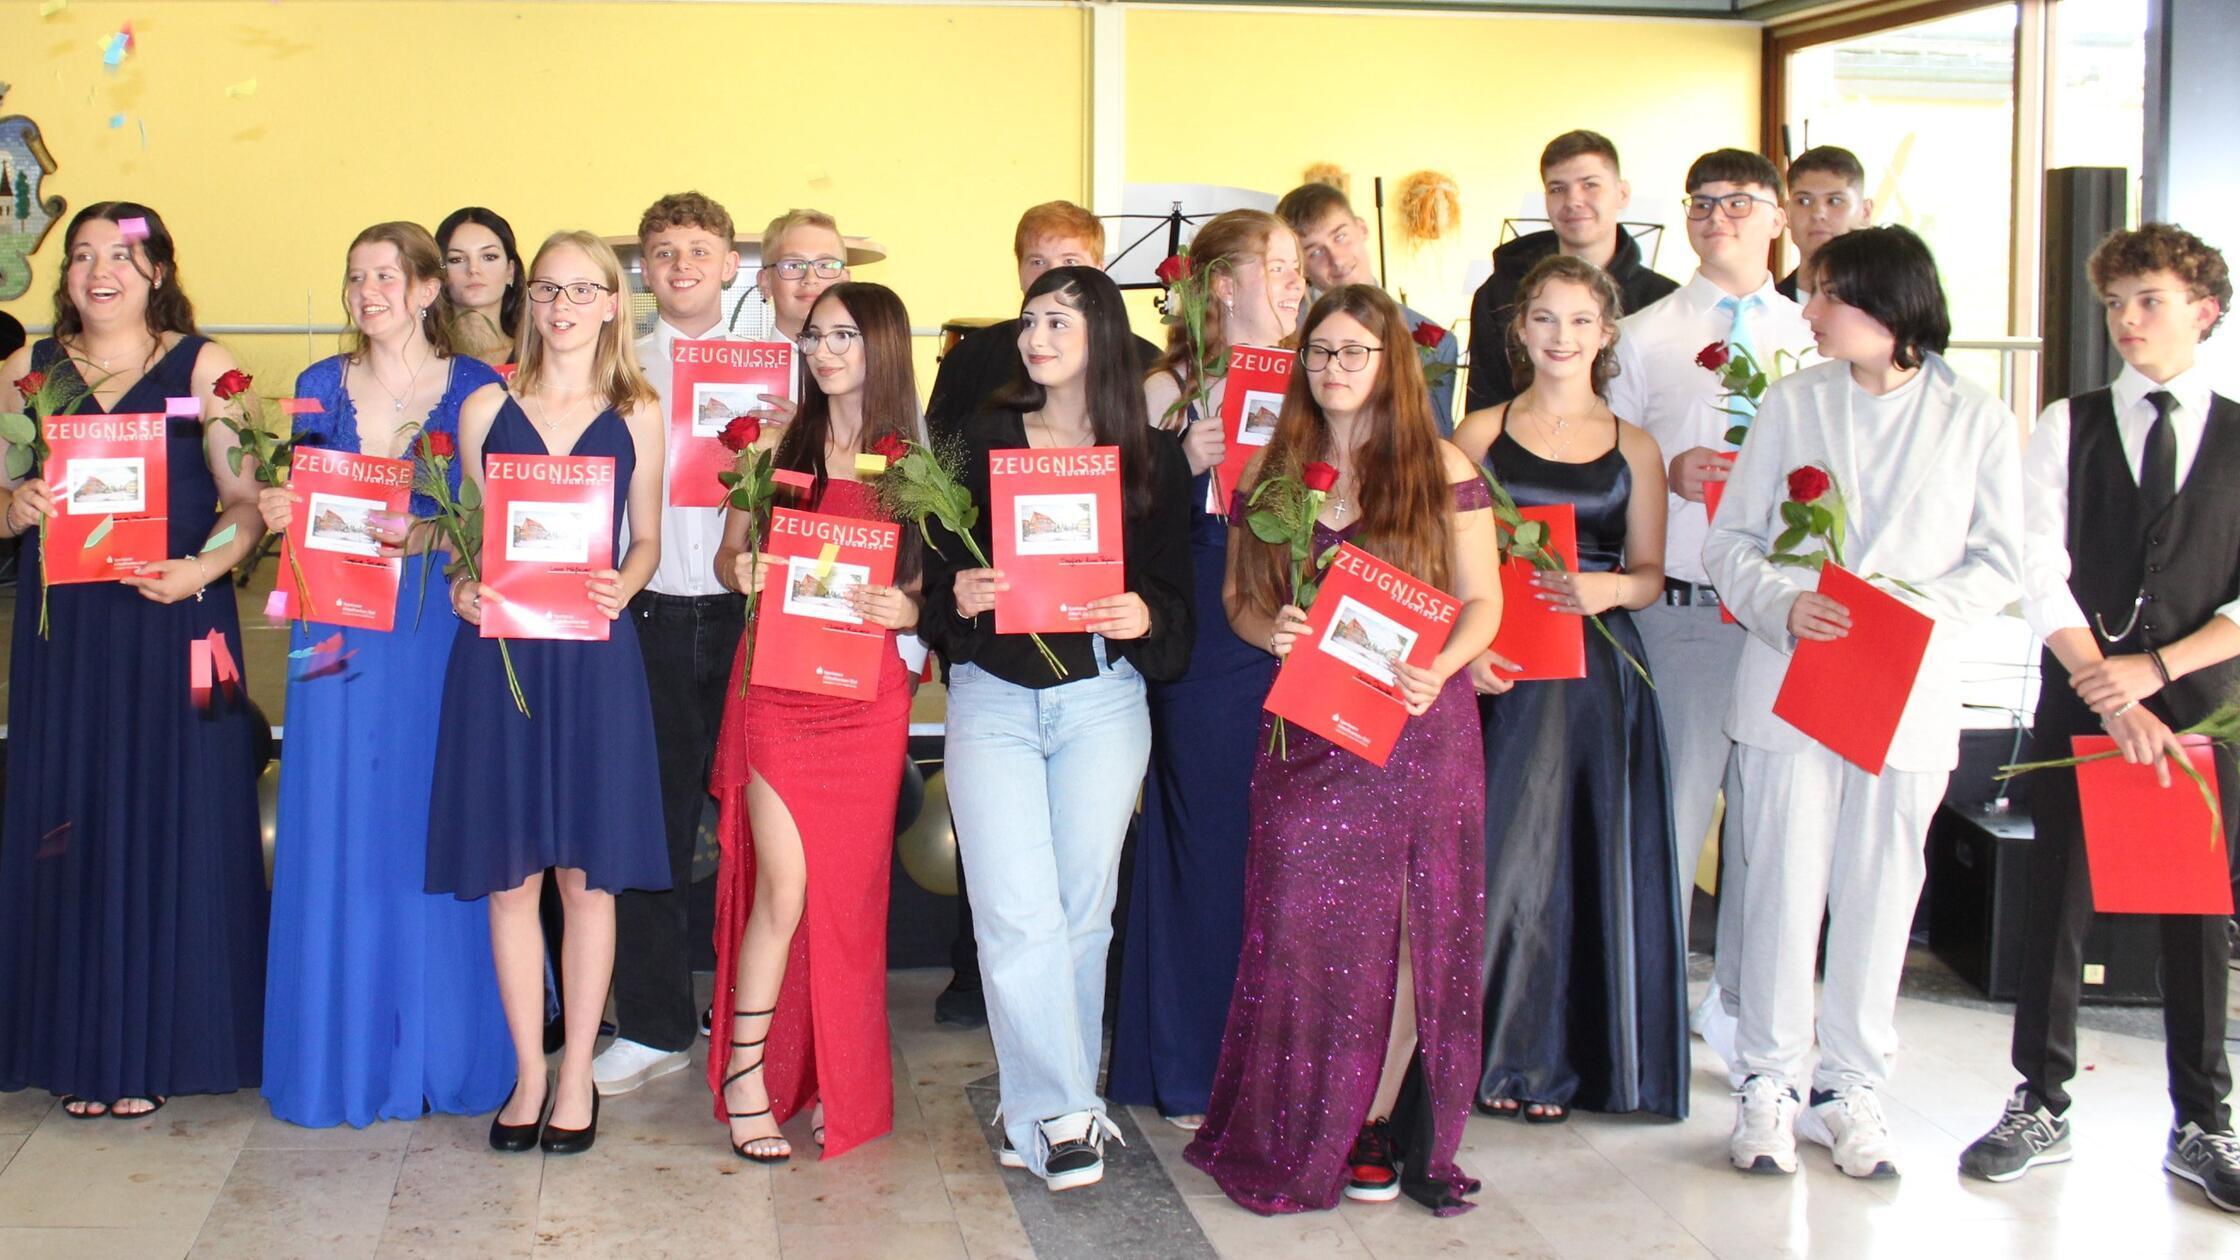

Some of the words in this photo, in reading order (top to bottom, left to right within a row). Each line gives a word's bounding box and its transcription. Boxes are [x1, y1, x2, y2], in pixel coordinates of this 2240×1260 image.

[675, 346, 788, 366] ZEUGNISSE
[46, 420, 164, 440] ZEUGNISSE
[295, 453, 412, 484] ZEUGNISSE
[489, 461, 612, 482] ZEUGNISSE
[992, 454, 1117, 475] ZEUGNISSE
[773, 515, 895, 548] ZEUGNISSE
[1334, 550, 1456, 624] ZEUGNISSE
